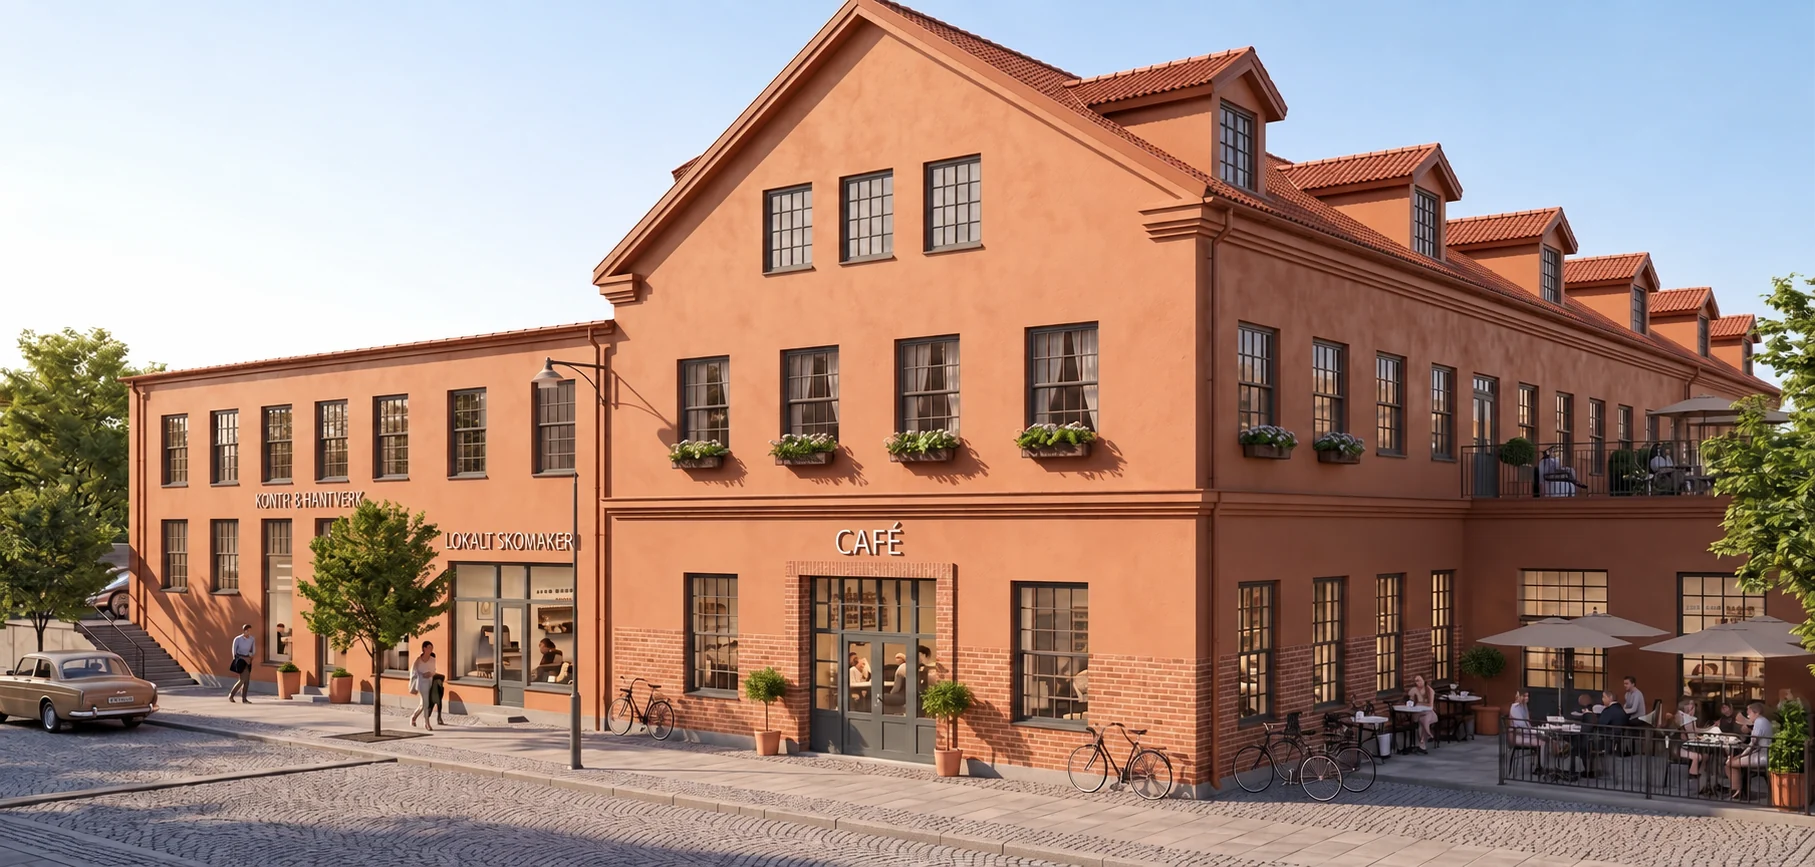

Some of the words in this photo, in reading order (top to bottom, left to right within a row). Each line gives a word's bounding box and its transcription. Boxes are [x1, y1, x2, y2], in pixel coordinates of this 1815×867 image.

[295, 491, 303, 508] &
[445, 531, 495, 550] LOKALT
[497, 531, 577, 551] SKOMAKER
[835, 521, 903, 555] CAFÉ
